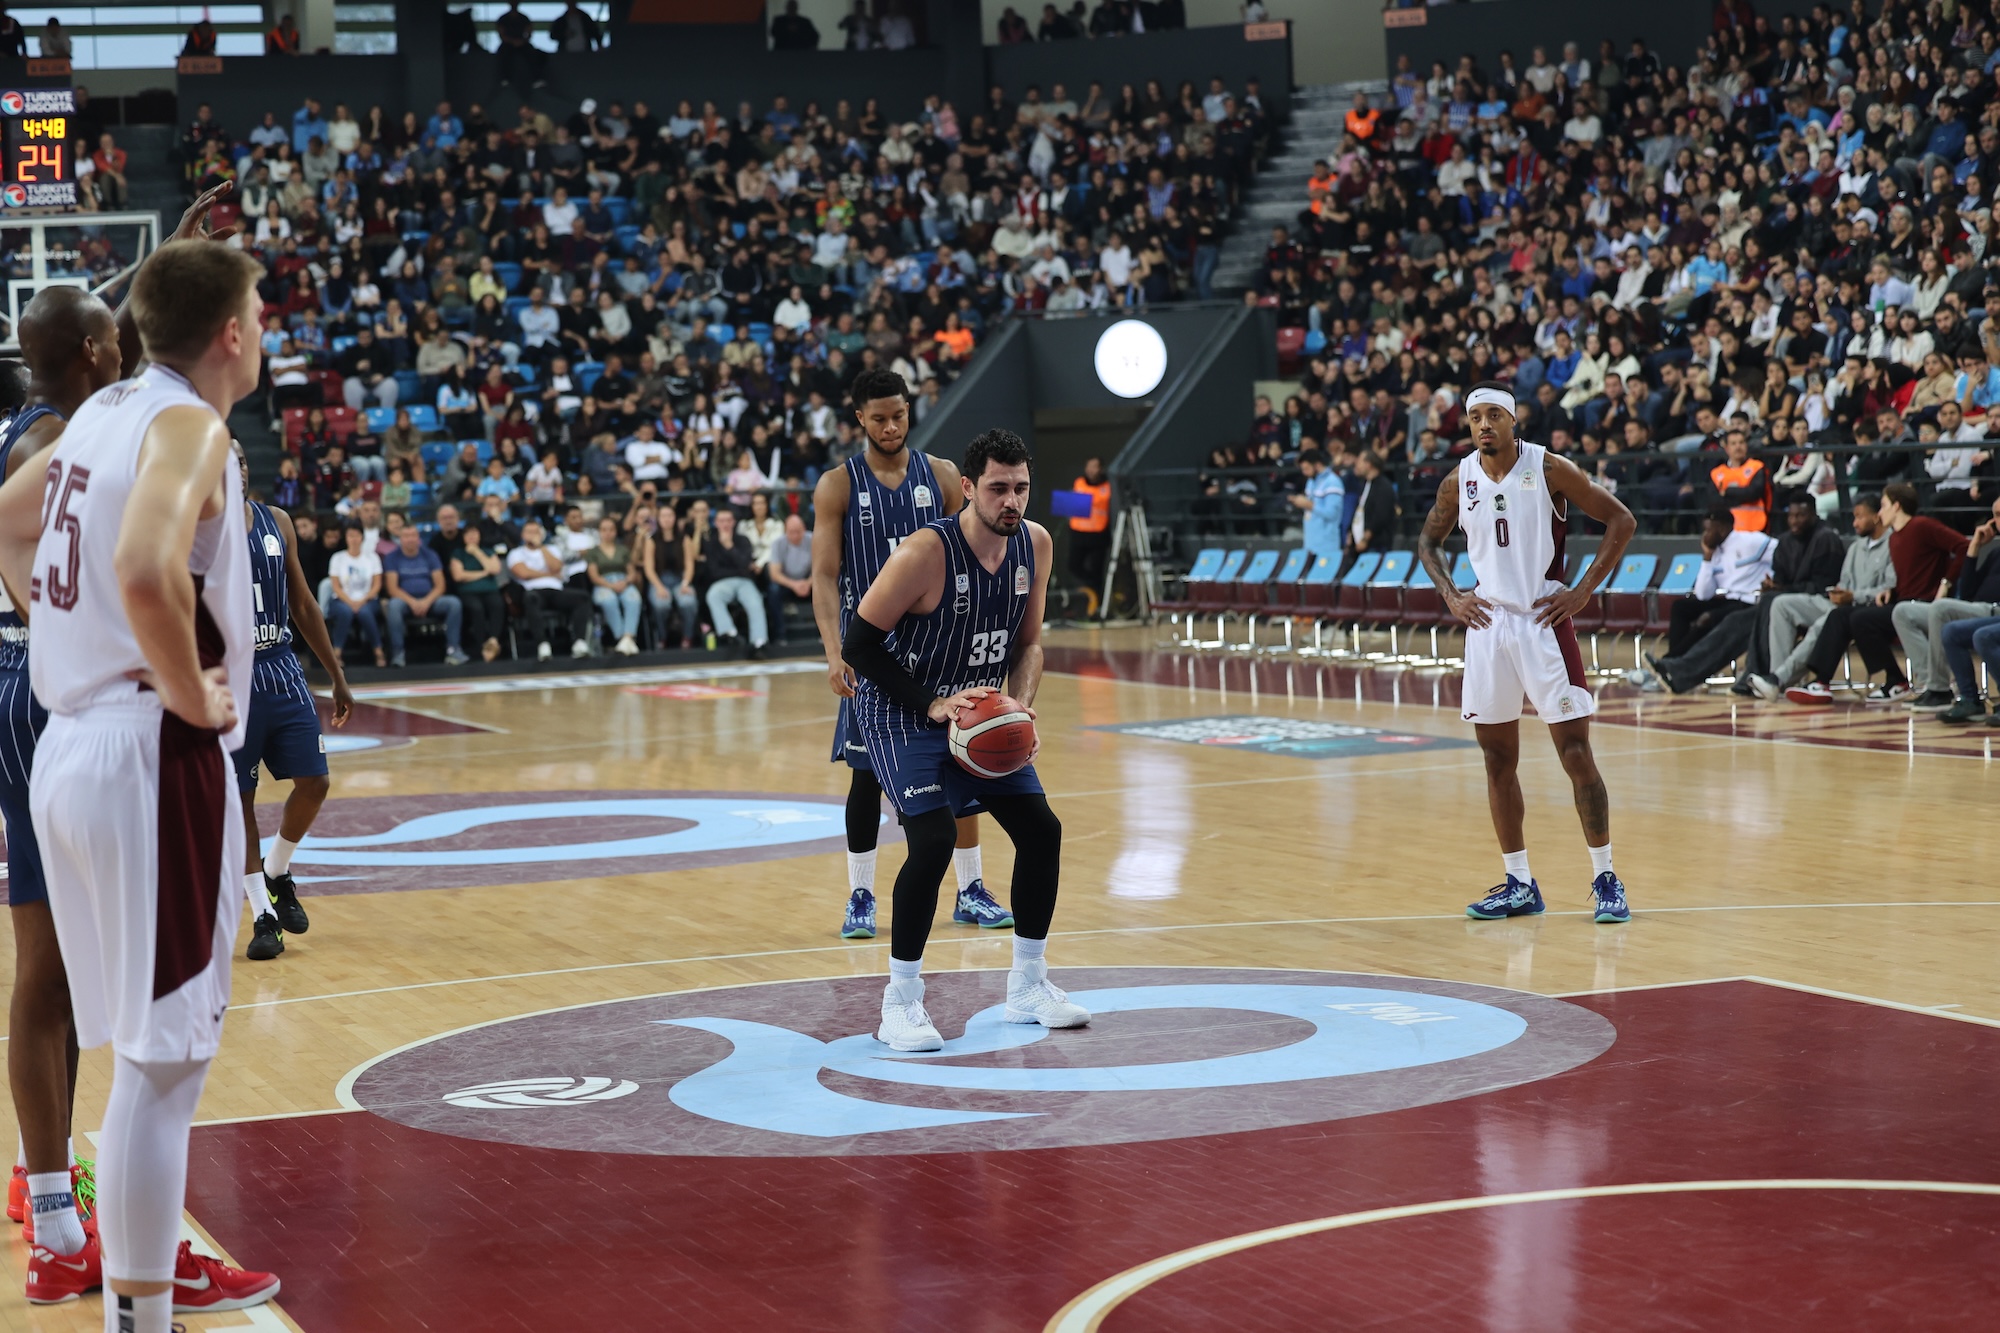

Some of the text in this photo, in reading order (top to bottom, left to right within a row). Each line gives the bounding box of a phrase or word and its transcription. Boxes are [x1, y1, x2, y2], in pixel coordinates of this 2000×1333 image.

[23, 119, 66, 139] 4:48
[18, 145, 61, 181] 24
[1496, 518, 1509, 547] 0
[968, 629, 1009, 667] 33
[1323, 1002, 1459, 1025] 1967
